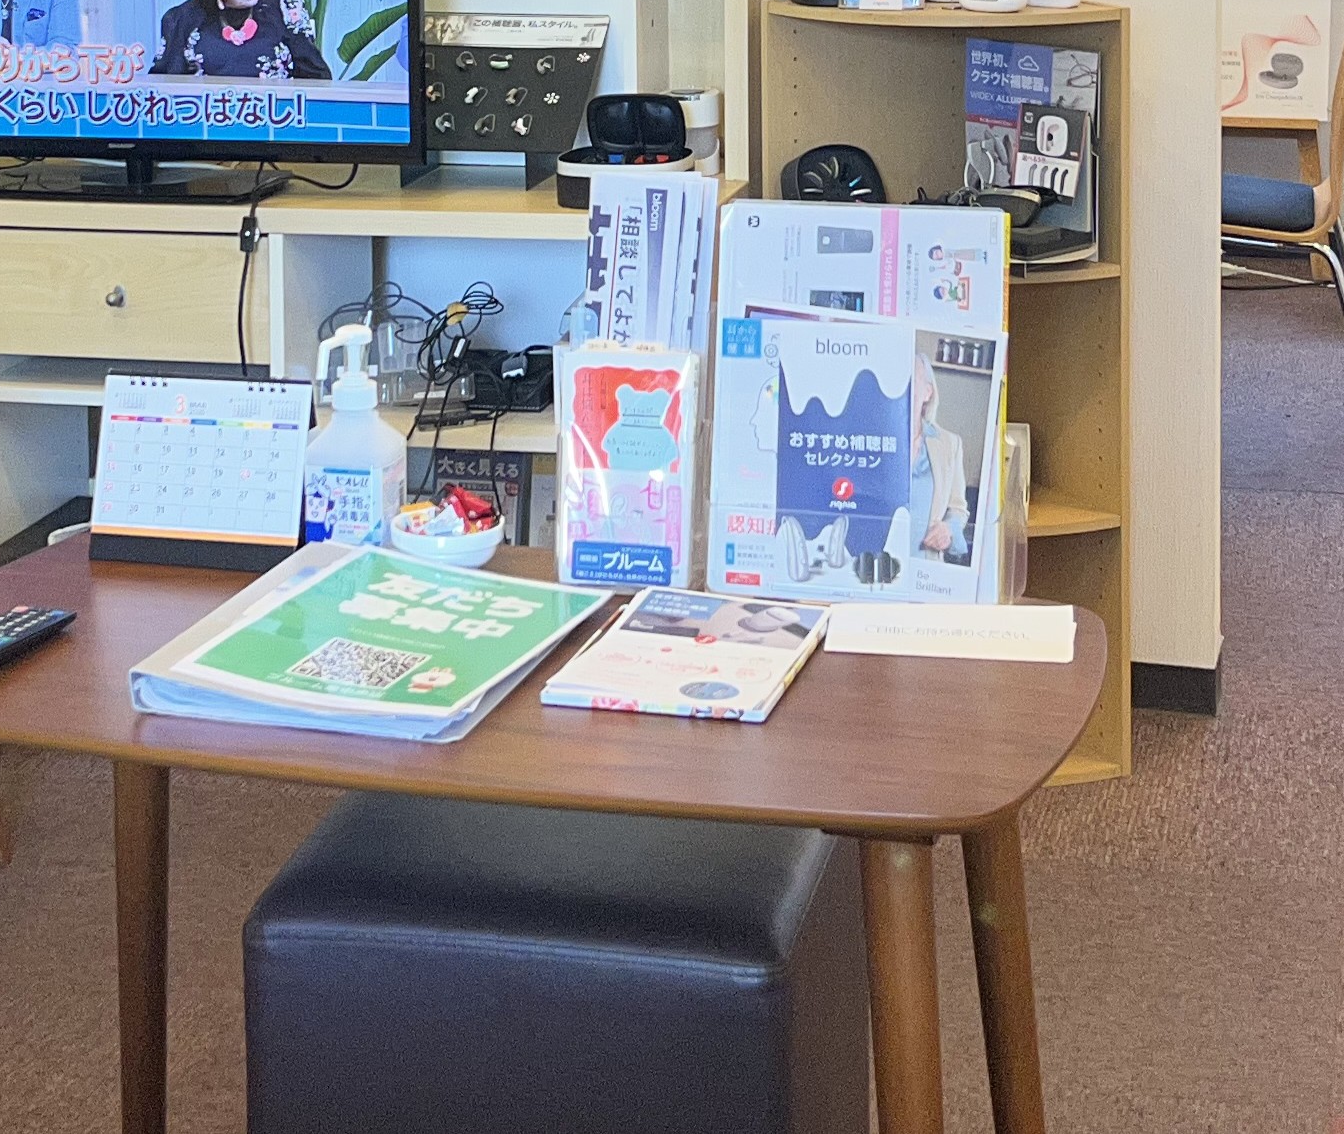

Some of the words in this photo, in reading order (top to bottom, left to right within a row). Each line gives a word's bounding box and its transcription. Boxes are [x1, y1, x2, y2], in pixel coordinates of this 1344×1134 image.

[473, 18, 578, 29] この補聴器、私スタイル。
[971, 50, 1008, 67] 世界初、
[971, 69, 1050, 93] クラウド補聴器。
[970, 90, 995, 102] WIDEX
[87, 88, 307, 128] しびれっぱなし!
[650, 192, 663, 232] bloom
[815, 338, 869, 356] bloom
[175, 394, 186, 415] 3
[789, 431, 897, 453] おすすめ補聴器
[804, 452, 882, 468] セレクション
[829, 500, 857, 511] signia
[602, 551, 666, 573] ブルーム
[916, 569, 930, 579] Be
[367, 572, 544, 619] 友だち
[915, 581, 952, 596] Brilliant
[338, 592, 516, 641] 募集中
